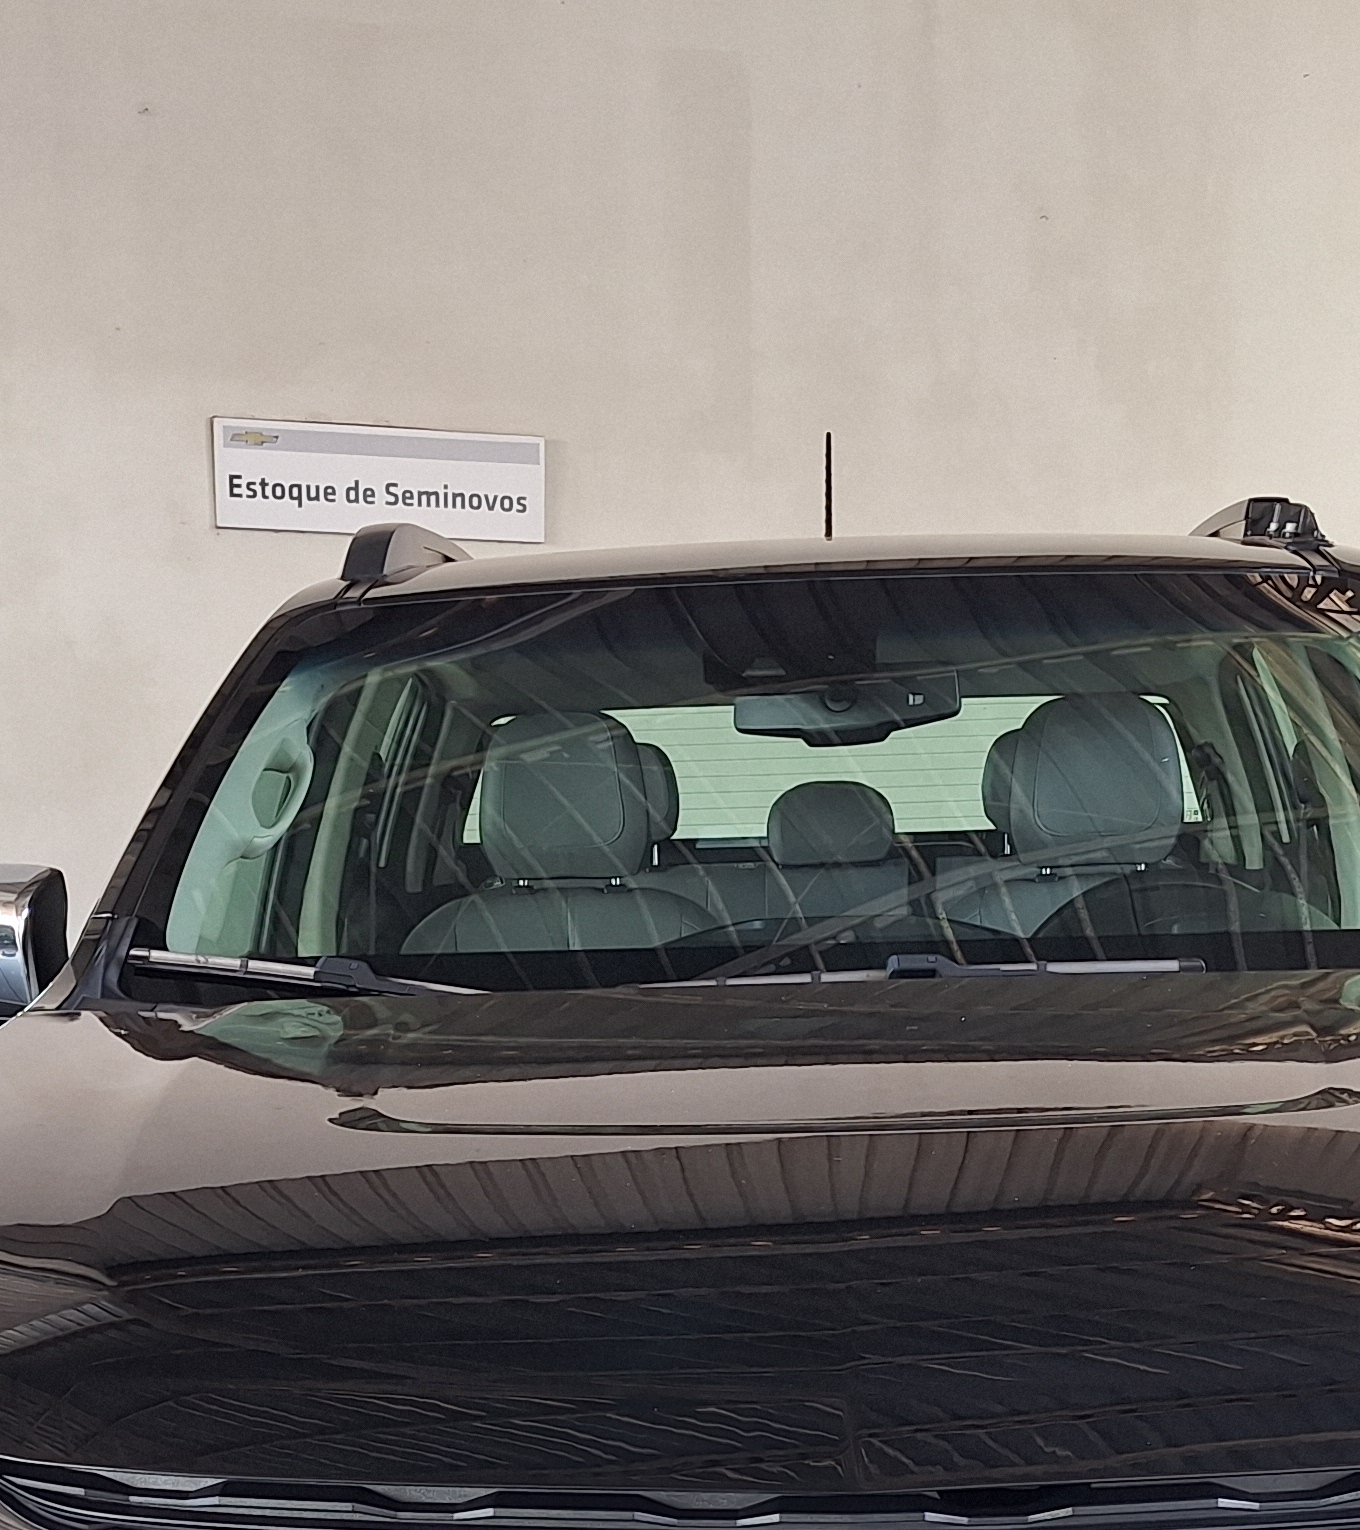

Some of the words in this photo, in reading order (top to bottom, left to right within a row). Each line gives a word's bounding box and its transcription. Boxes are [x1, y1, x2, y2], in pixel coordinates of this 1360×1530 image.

[228, 474, 337, 508] Estoque
[345, 480, 376, 505] de
[384, 482, 528, 513] Seminovos
